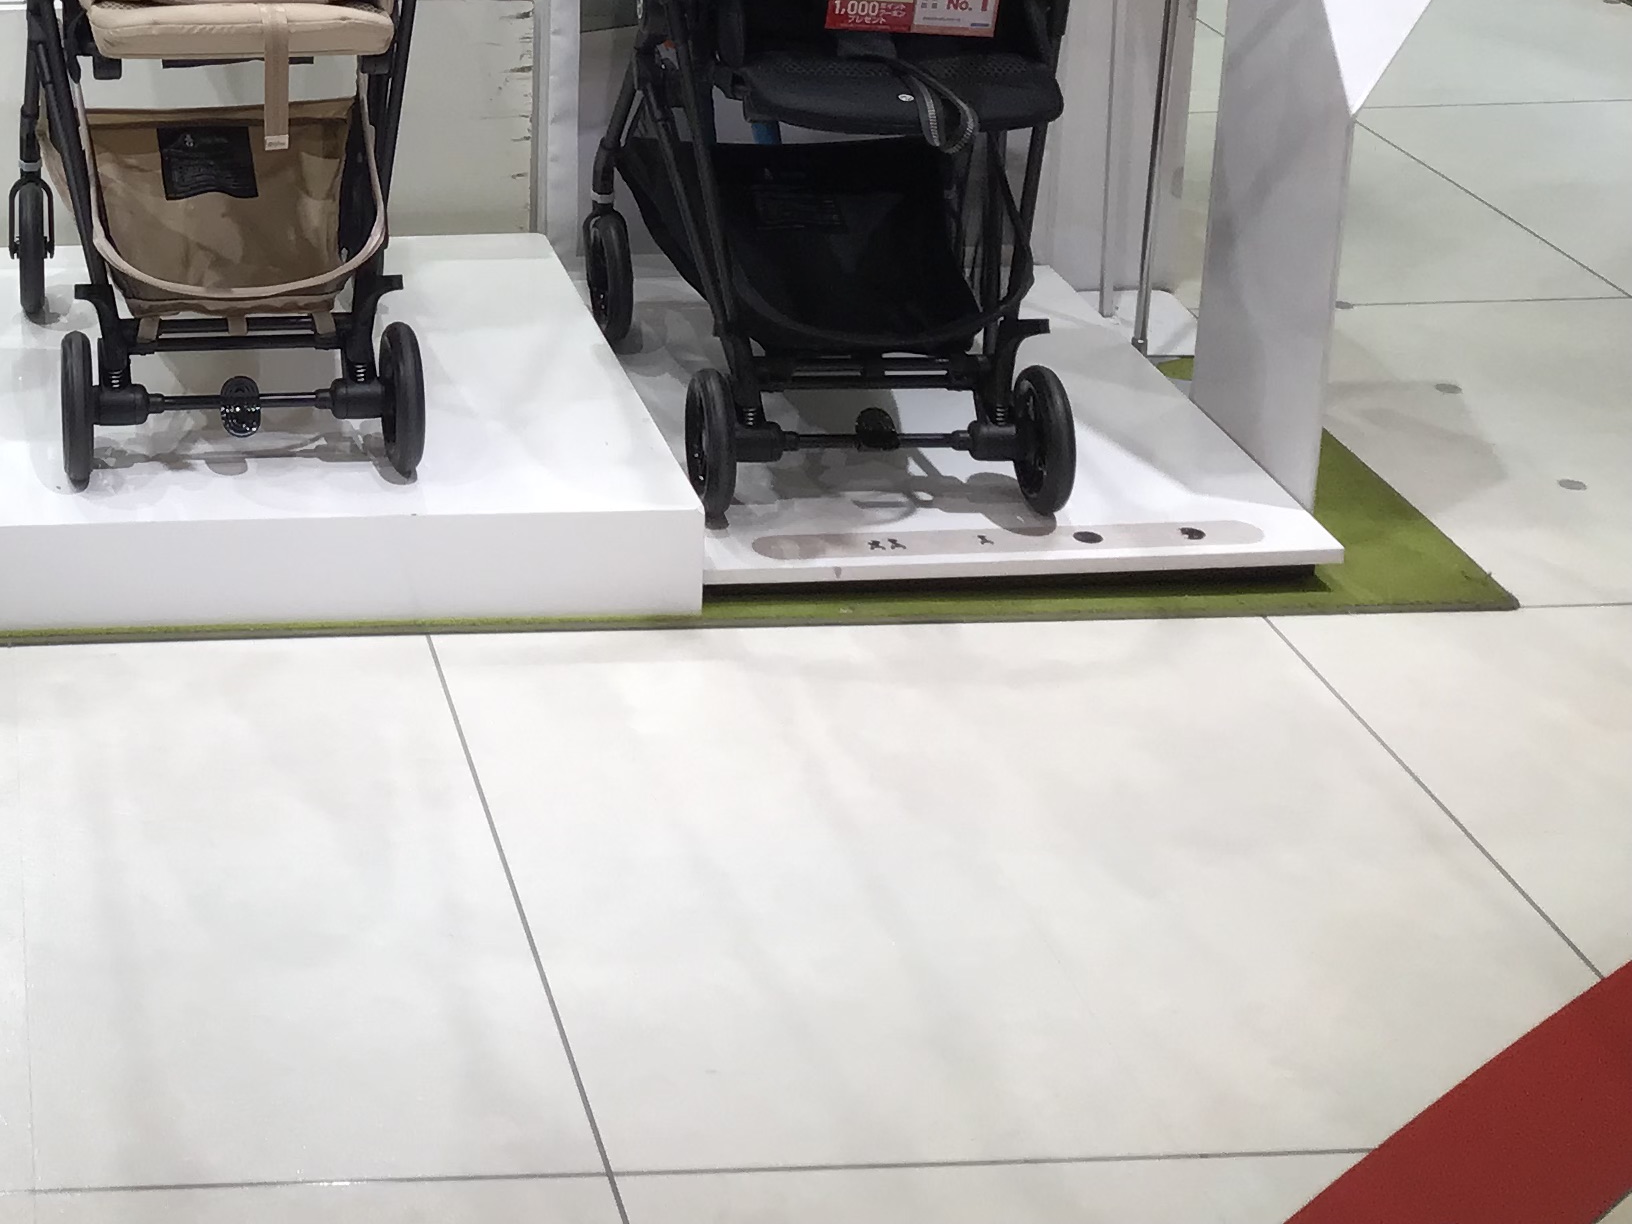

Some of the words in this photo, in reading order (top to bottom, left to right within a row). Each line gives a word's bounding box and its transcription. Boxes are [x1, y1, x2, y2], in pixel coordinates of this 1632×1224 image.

[833, 0, 879, 16] 1,000
[847, 15, 887, 25] プレゼント
